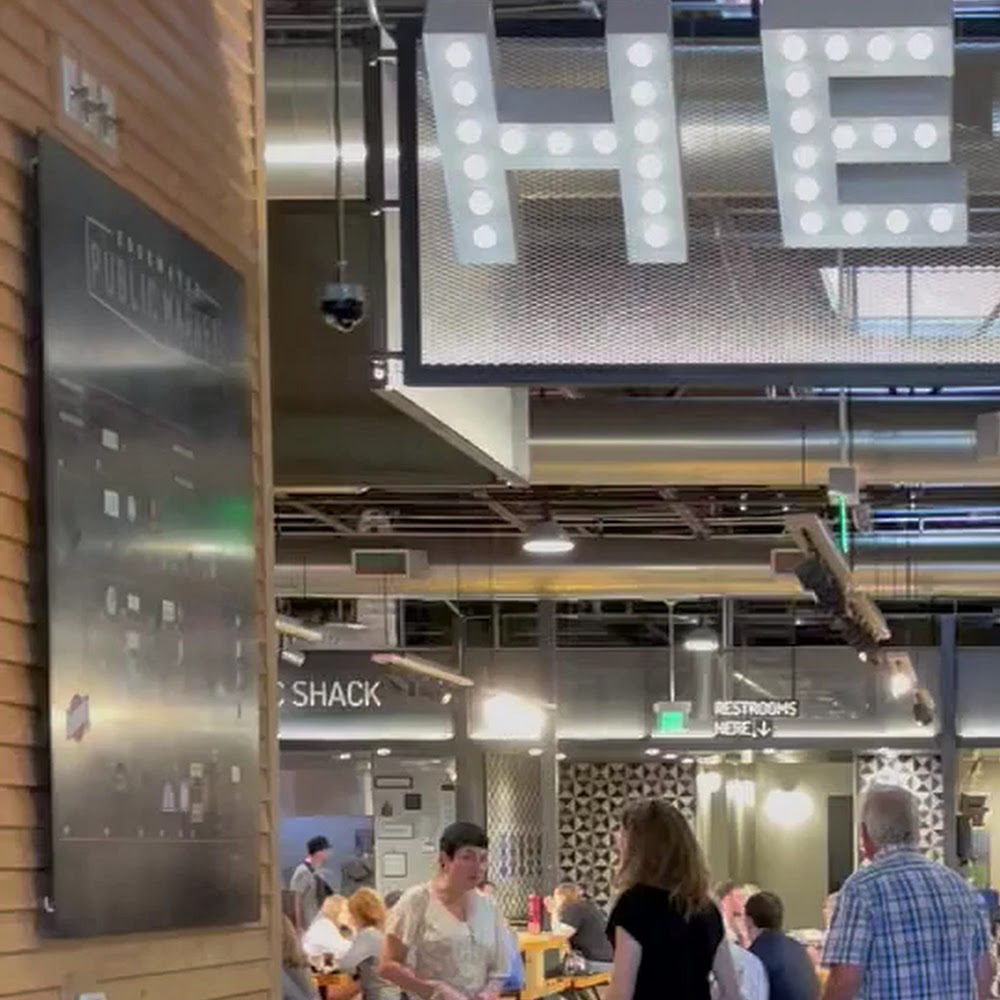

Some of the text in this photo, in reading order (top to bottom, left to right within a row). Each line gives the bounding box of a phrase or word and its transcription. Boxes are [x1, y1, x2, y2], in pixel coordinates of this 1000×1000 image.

[91, 240, 158, 321] PUBLIC
[292, 680, 382, 708] SHACK
[714, 700, 798, 716] RESTROOMS
